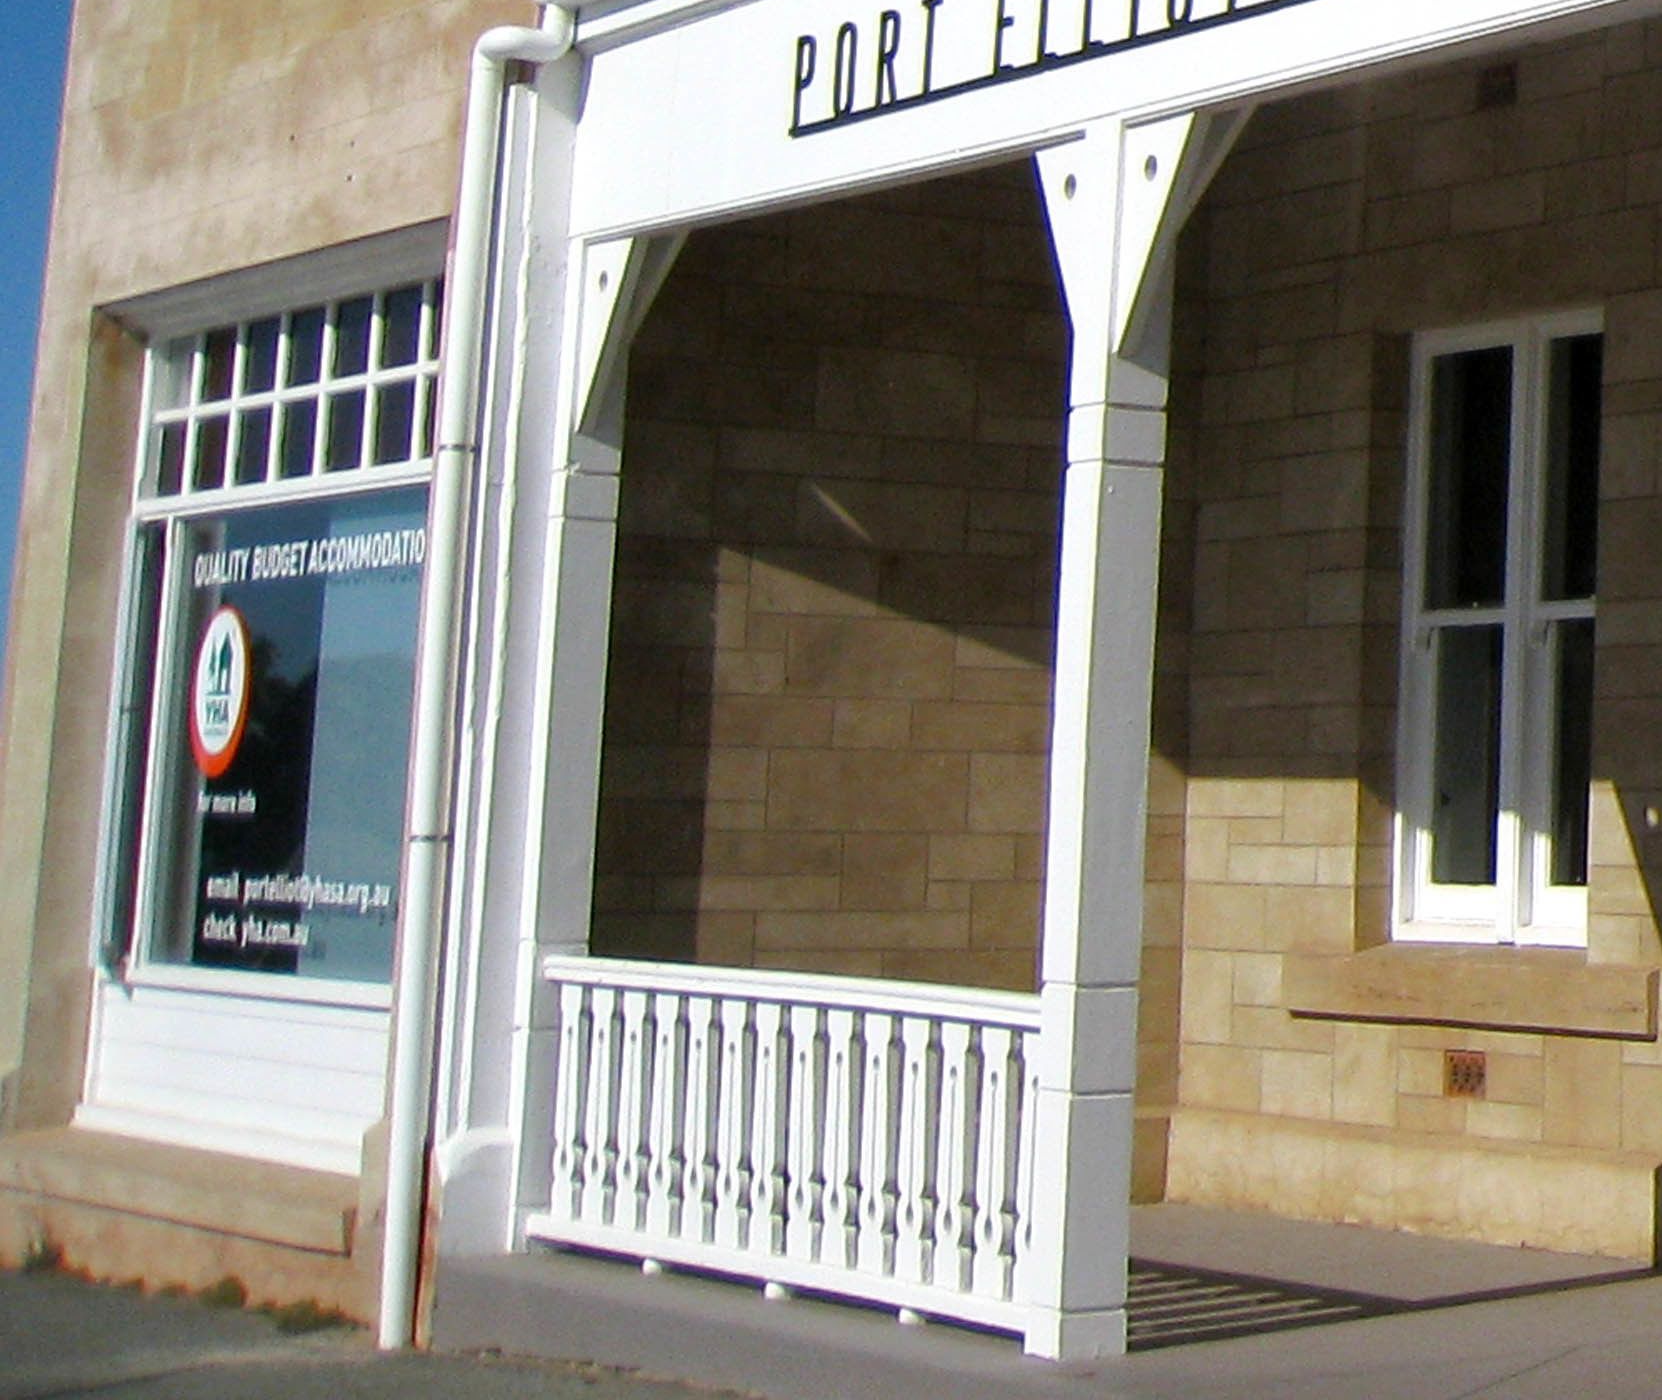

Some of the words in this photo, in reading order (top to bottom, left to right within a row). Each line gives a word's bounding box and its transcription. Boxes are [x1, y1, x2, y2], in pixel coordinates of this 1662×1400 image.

[194, 549, 250, 588] QUALITY
[251, 540, 309, 580] BUDGET
[307, 528, 426, 573] ACCOMMODATIO
[206, 699, 229, 725] YHA
